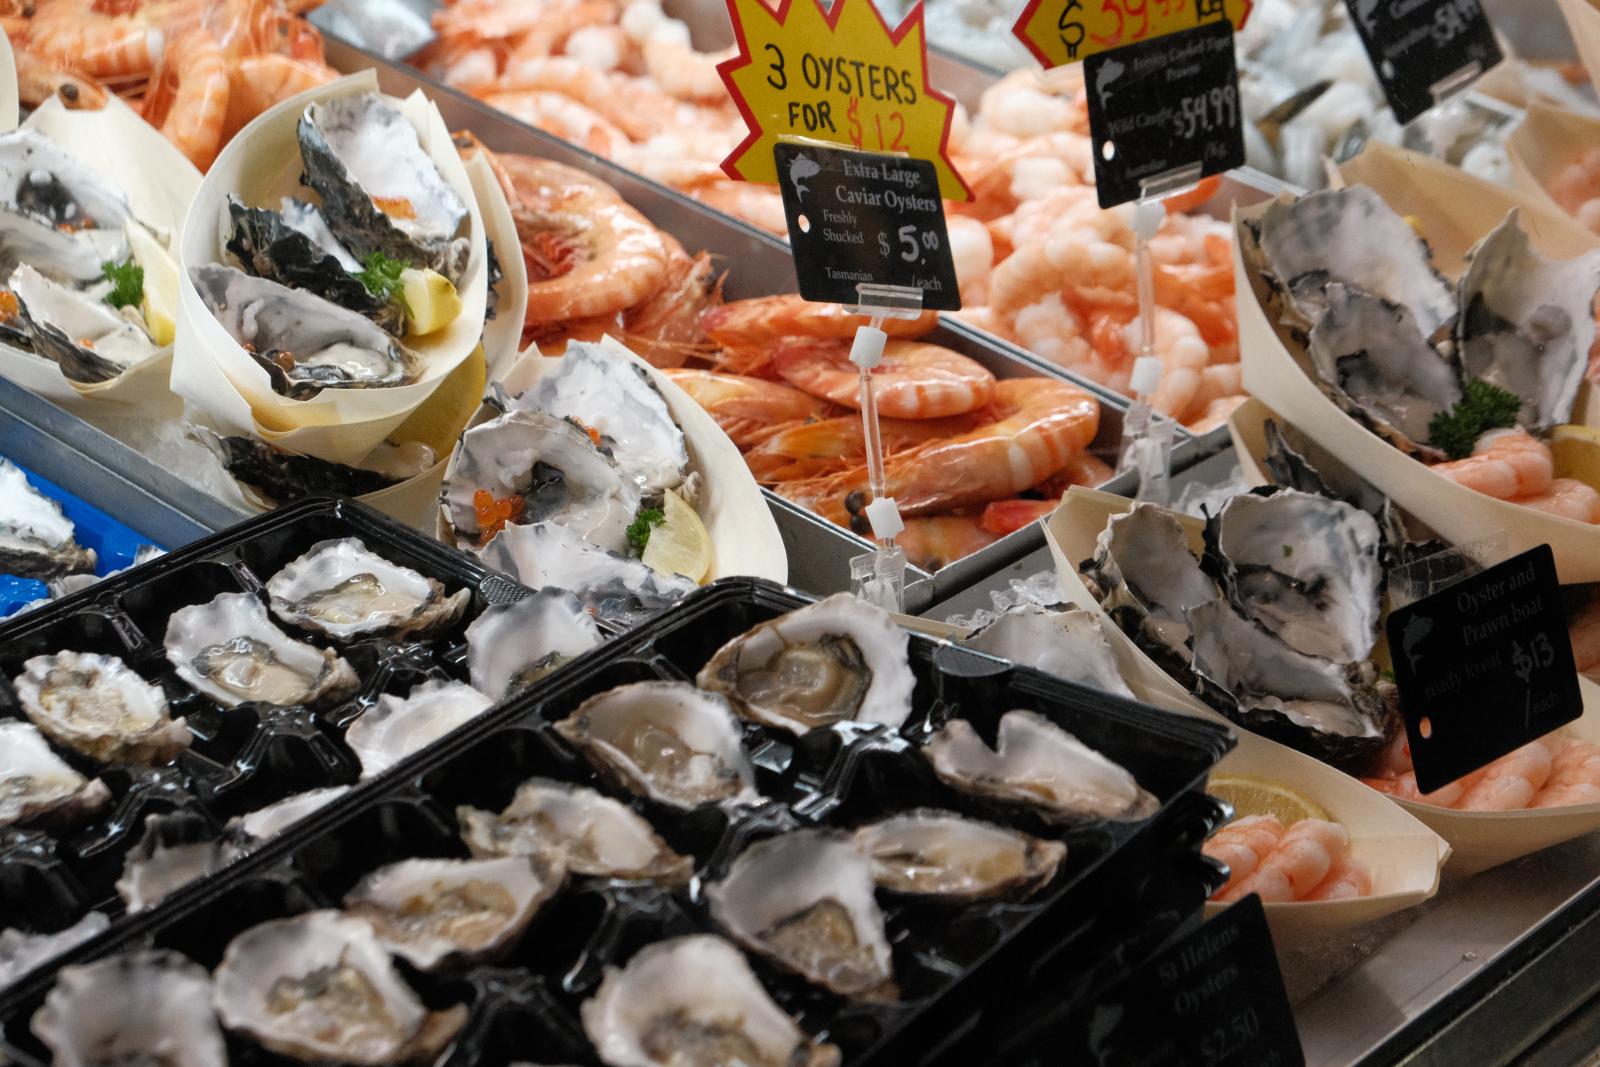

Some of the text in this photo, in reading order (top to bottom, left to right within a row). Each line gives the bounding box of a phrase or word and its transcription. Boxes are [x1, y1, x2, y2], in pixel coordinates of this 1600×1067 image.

[764, 43, 917, 105] 3 OYSTERS
[788, 101, 837, 133] FOR
[835, 184, 938, 214] Caviar Oysters
[822, 208, 858, 229] Freshly
[823, 228, 864, 244] Shucked
[825, 266, 873, 282] Tasmanian
[1456, 560, 1537, 616] Oyster and
[1461, 596, 1545, 648] Prawn boat
[1424, 665, 1464, 701] ready
[1510, 631, 1555, 684] $13
